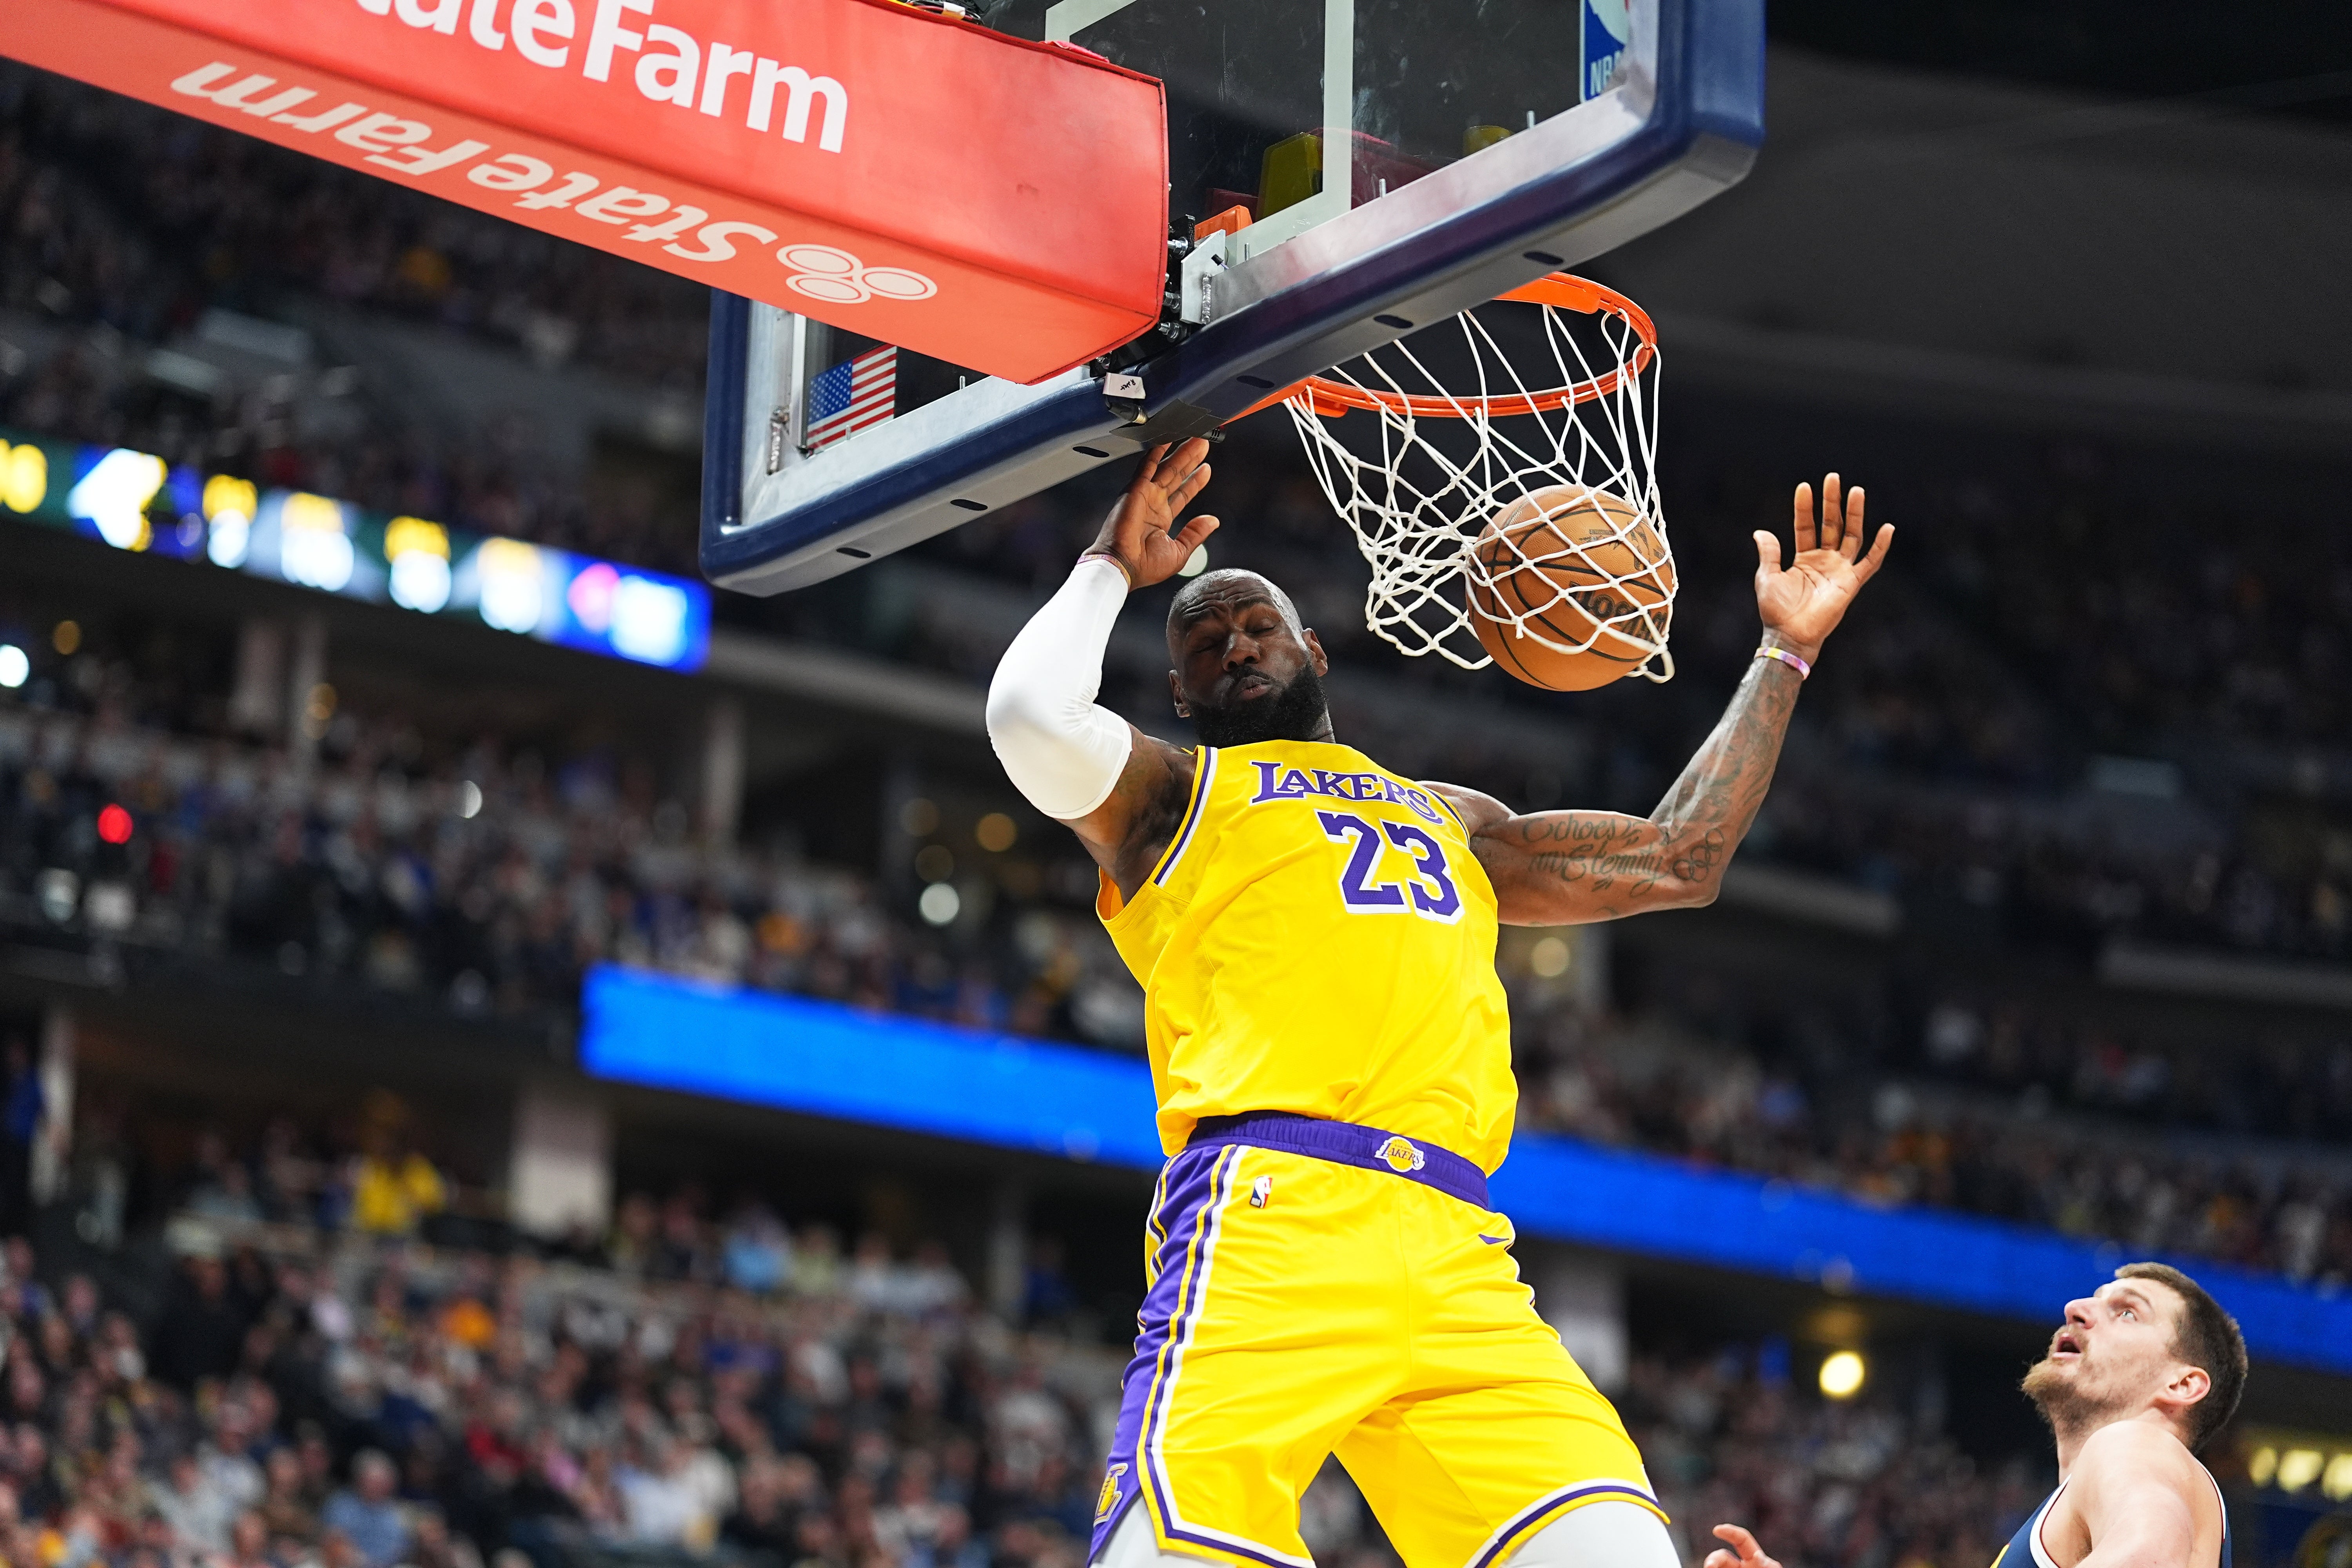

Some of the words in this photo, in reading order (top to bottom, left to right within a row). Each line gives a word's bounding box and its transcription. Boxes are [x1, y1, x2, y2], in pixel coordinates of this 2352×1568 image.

[355, 0, 848, 153] teFarm
[1590, 50, 1622, 96] NB
[170, 61, 778, 262] StateFarm
[1249, 761, 1445, 826] LAKERS
[1313, 808, 1465, 926] 23
[1377, 1142, 1423, 1168] LAKERS
